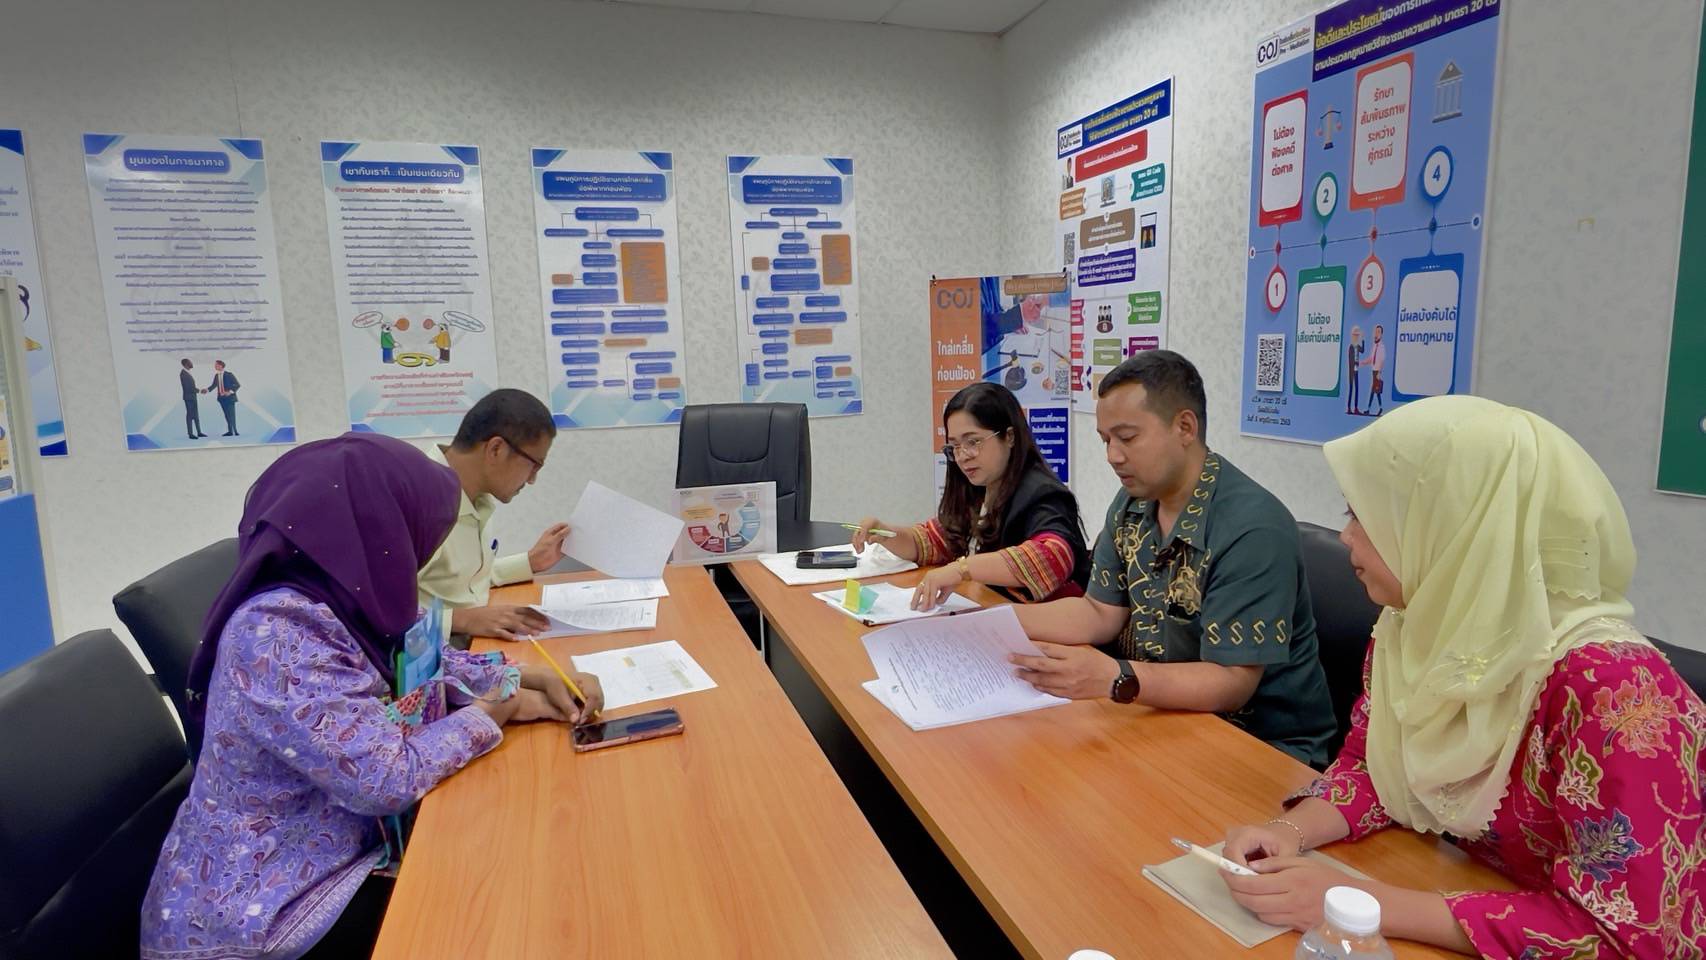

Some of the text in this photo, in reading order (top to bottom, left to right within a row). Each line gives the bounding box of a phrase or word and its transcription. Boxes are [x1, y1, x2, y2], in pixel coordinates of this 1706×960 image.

[1444, 5, 1469, 22] มาตรา
[1470, 0, 1484, 12] 20
[1257, 39, 1278, 63] COJ
[1374, 87, 1394, 102] รักษา
[1360, 103, 1407, 125] สัมพันธภาพ
[1273, 126, 1295, 141] ไม่ต้อง
[1368, 125, 1396, 142] ระหว่าง
[1271, 141, 1296, 159] ฟ้องคดี
[1368, 142, 1393, 165] คู่กรณี
[129, 155, 225, 167] มุมมองในการมาศาล
[1271, 163, 1294, 176] ต่อศาล
[1432, 164, 1441, 181] 4
[1323, 189, 1329, 204] 2
[1274, 283, 1279, 297] 1
[1366, 275, 1374, 290] 3
[936, 287, 974, 309] COJ
[1308, 312, 1331, 325] ไม่ต้อง
[1399, 305, 1457, 322] มีผลบังคับได้
[1297, 326, 1340, 343] เสียค่าขึ้นศาล
[1399, 332, 1454, 345] ตามกฎหมาย
[937, 335, 974, 355] ไกล่เกลี่ย
[937, 363, 976, 381] ก่อนฟ้อง
